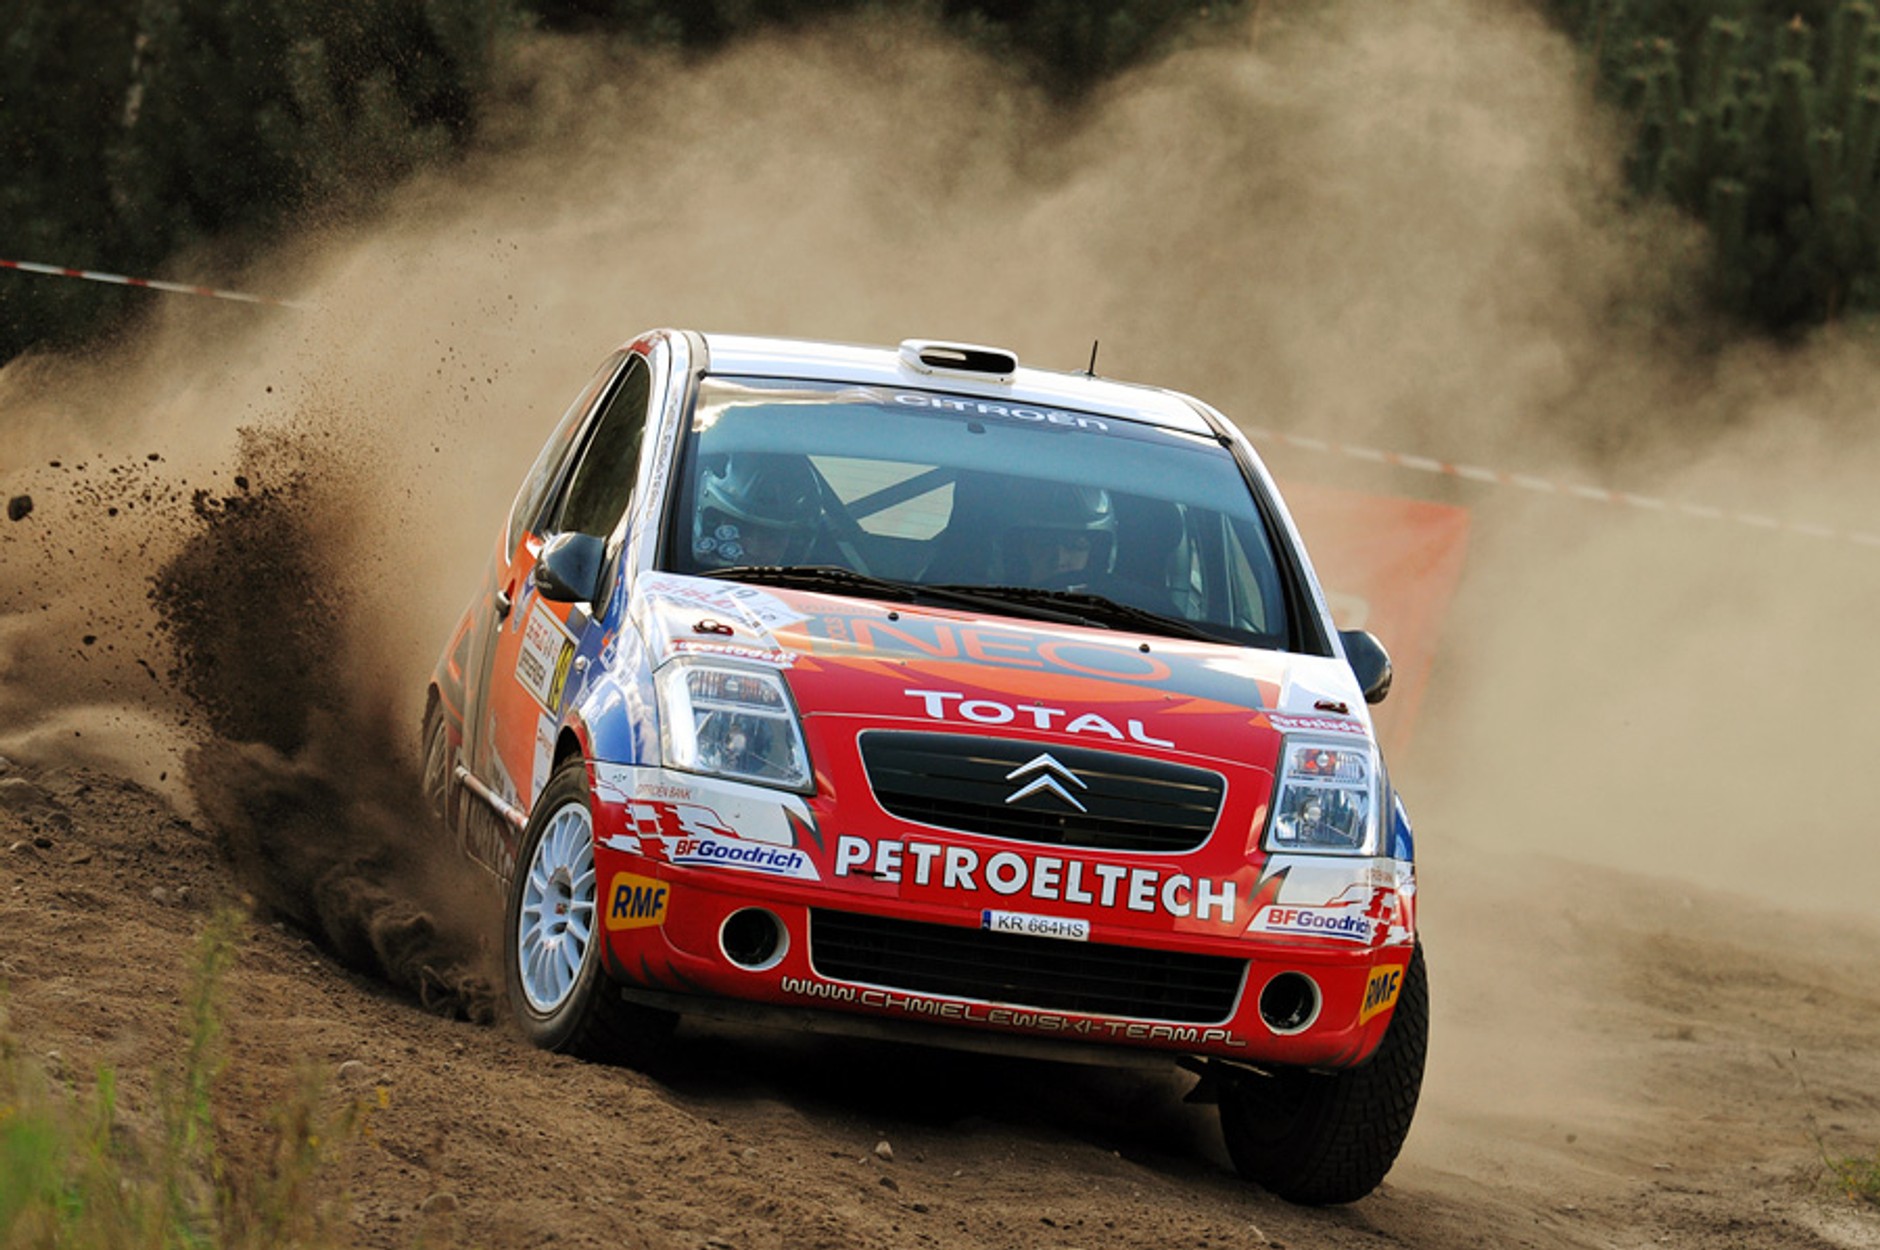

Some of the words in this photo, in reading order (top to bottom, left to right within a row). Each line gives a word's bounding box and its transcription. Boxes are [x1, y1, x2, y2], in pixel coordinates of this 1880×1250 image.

[848, 618, 1172, 682] NEO
[904, 689, 1175, 748] TOTAL
[675, 840, 803, 869] BFGoodrich
[834, 834, 1237, 923] PETROELTECH
[611, 884, 666, 918] RMF
[1267, 909, 1372, 935] BFGoodrich
[998, 915, 1023, 931] KR
[1028, 917, 1084, 938] 664HS
[781, 975, 1248, 1046] WWW.CHMIELEWSKI-TEAM.PL
[1364, 970, 1400, 1013] RMF
